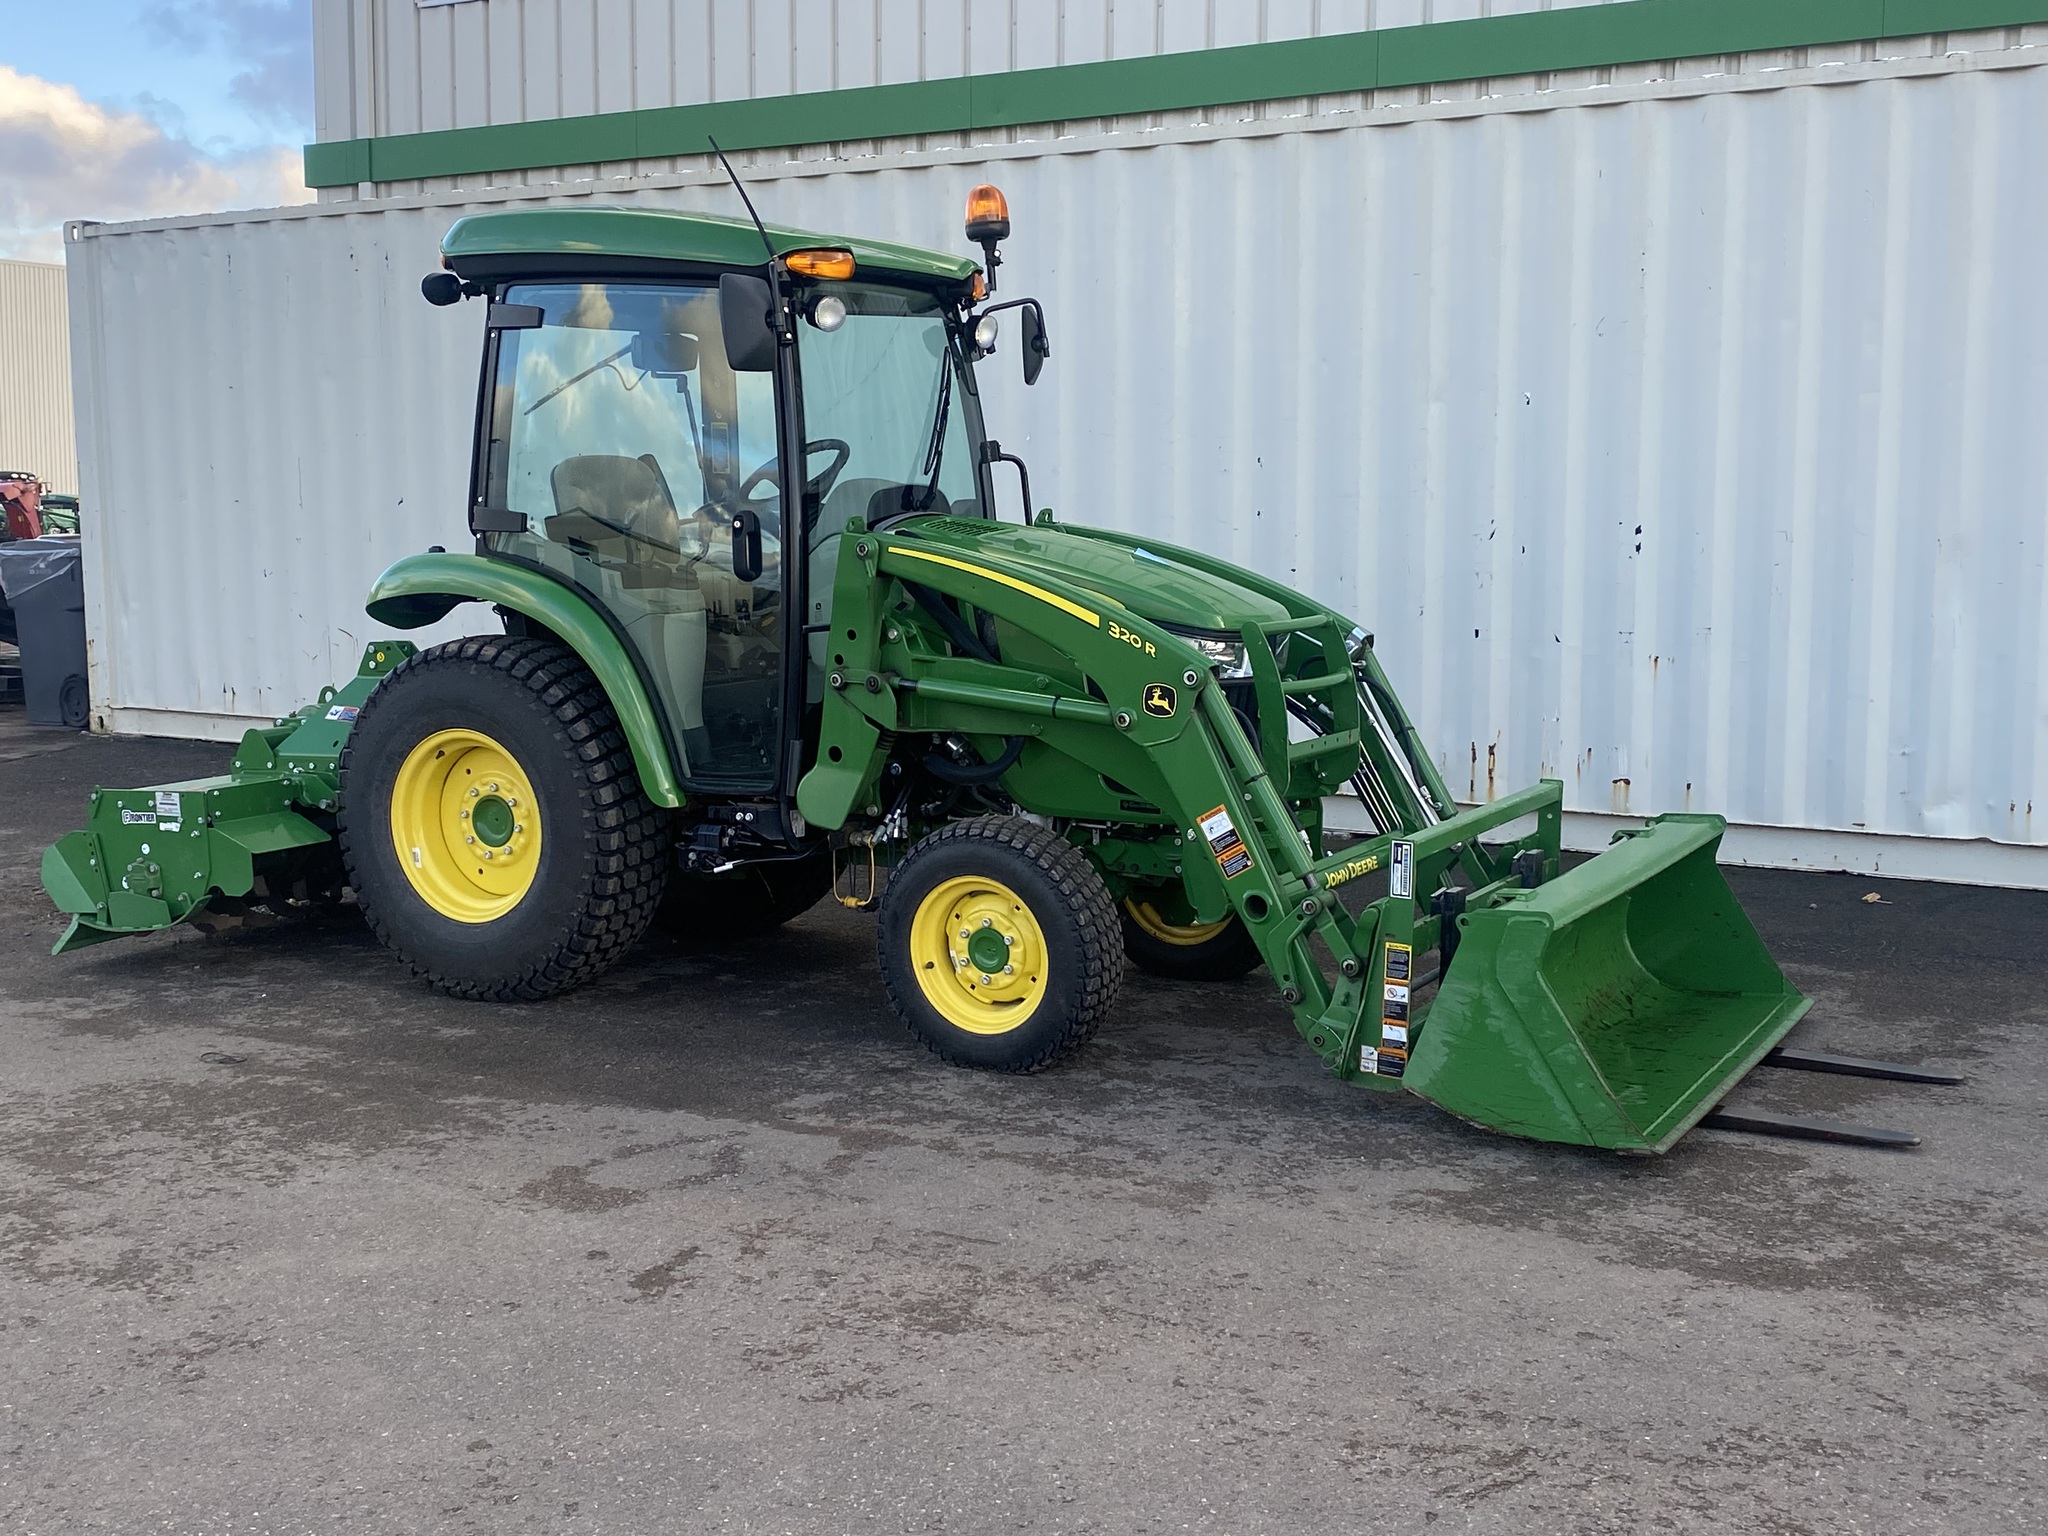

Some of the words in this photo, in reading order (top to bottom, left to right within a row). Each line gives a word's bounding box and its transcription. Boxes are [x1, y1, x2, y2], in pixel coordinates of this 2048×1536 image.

[1108, 621, 1142, 648] 320
[1145, 641, 1156, 658] R
[1325, 867, 1349, 889] JOHN
[1347, 855, 1378, 879] DEERE
